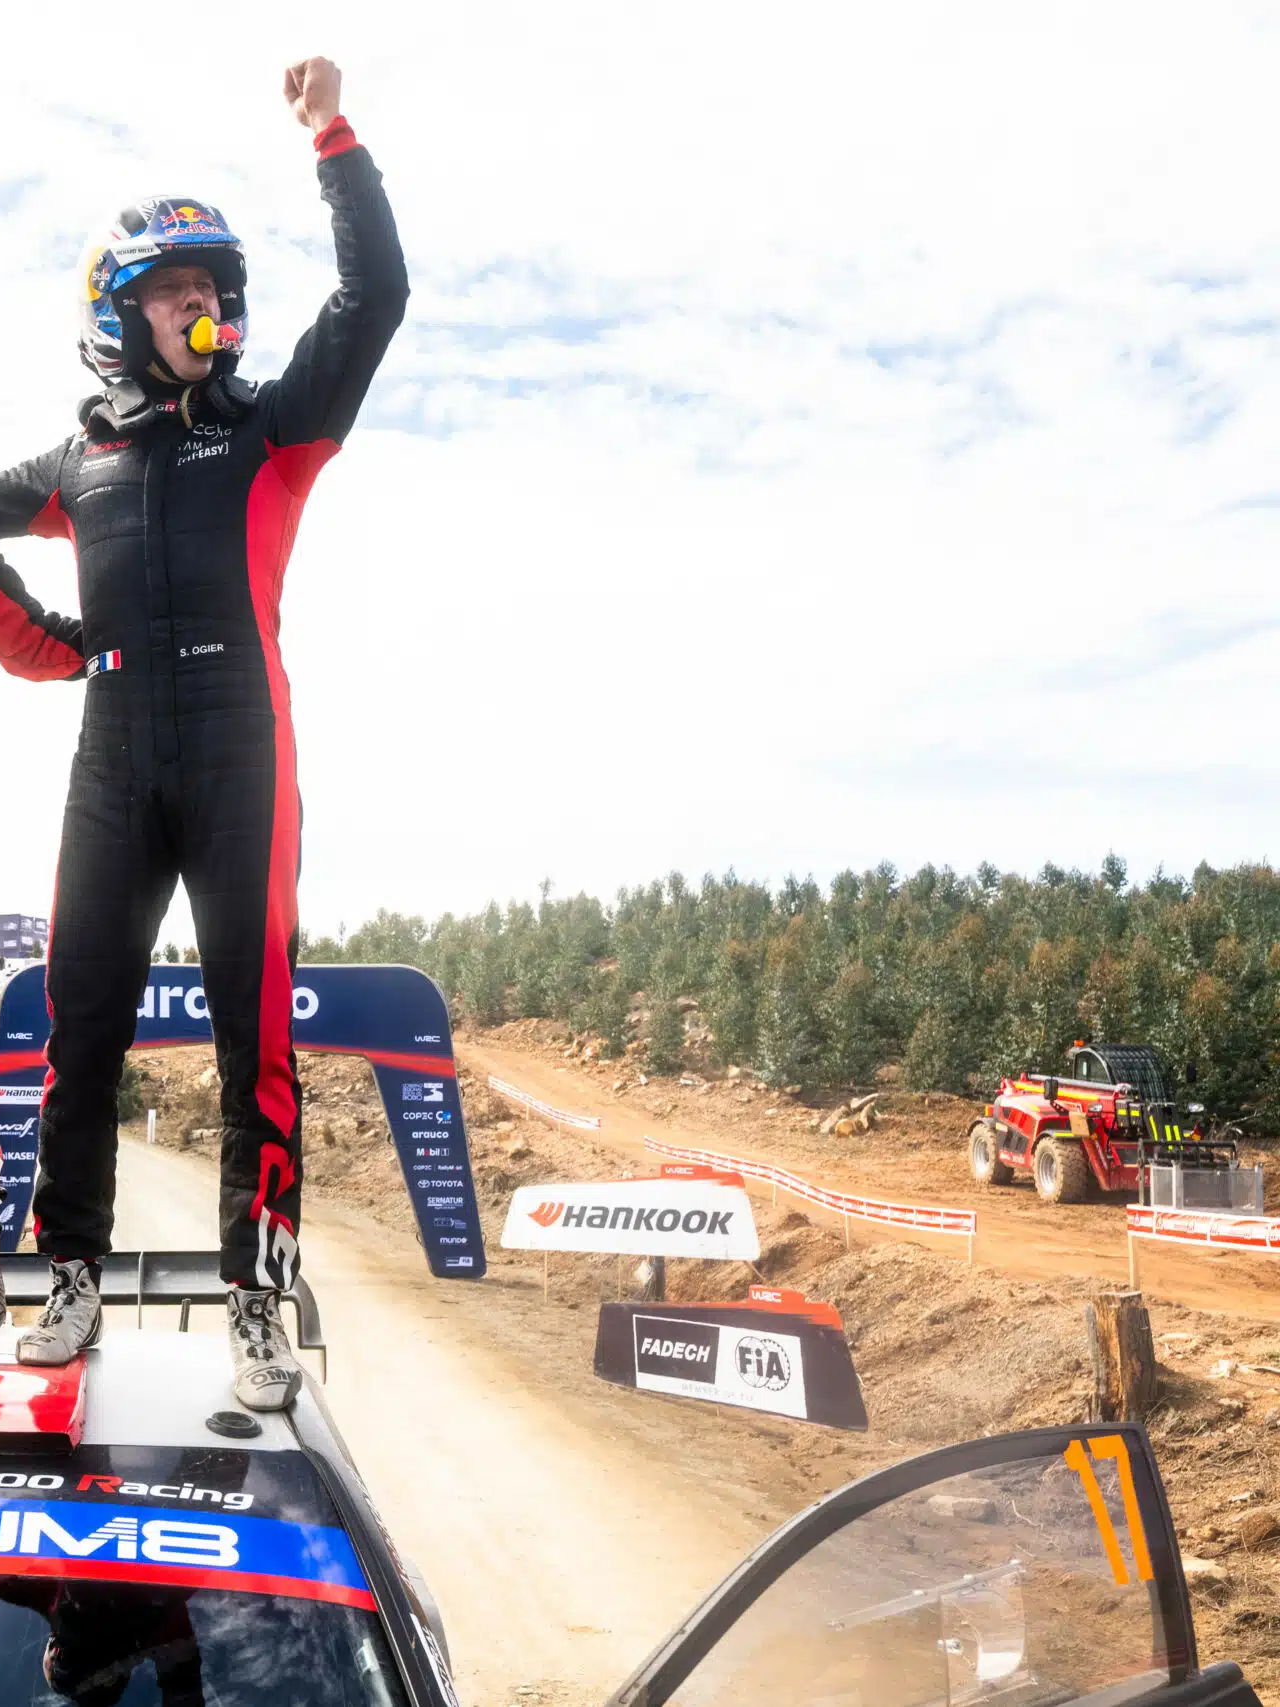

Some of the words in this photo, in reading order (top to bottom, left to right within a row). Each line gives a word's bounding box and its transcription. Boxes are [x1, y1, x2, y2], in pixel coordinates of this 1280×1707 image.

[180, 648, 190, 658] S.
[192, 643, 224, 655] OGIER
[7, 1032, 33, 1040] WRC
[414, 1034, 441, 1043] WRC
[416, 1148, 440, 1156] Mobil
[664, 1166, 695, 1175] WRC
[751, 1290, 782, 1303] WRC
[640, 1337, 711, 1363] FADECH
[76, 1474, 255, 1511] Racing
[1063, 1434, 1154, 1586] 17
